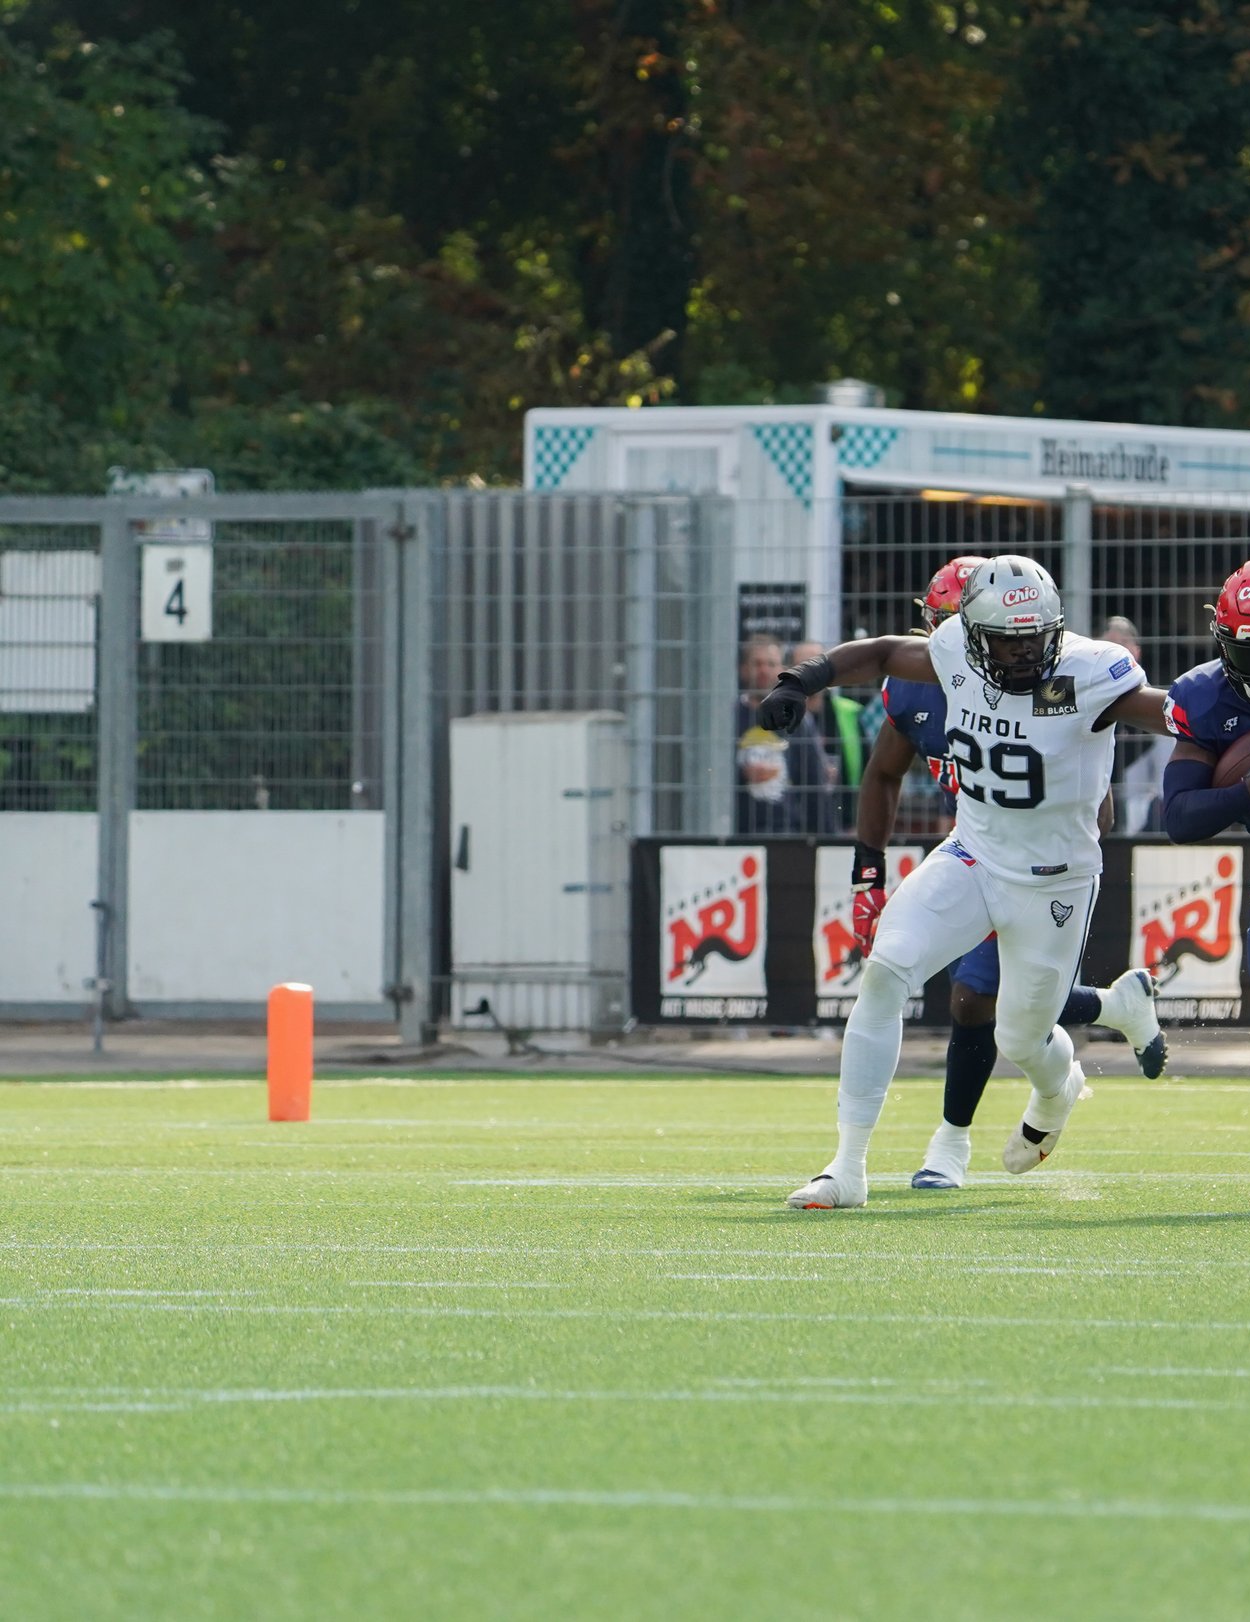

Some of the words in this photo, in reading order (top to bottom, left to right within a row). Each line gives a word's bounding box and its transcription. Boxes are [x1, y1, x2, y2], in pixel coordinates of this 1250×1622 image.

[165, 579, 187, 625] 4
[1003, 586, 1039, 607] Chio
[961, 708, 1027, 739] TIROL
[1034, 707, 1044, 715] 28
[1047, 705, 1077, 715] BLACK
[946, 727, 1045, 809] 29
